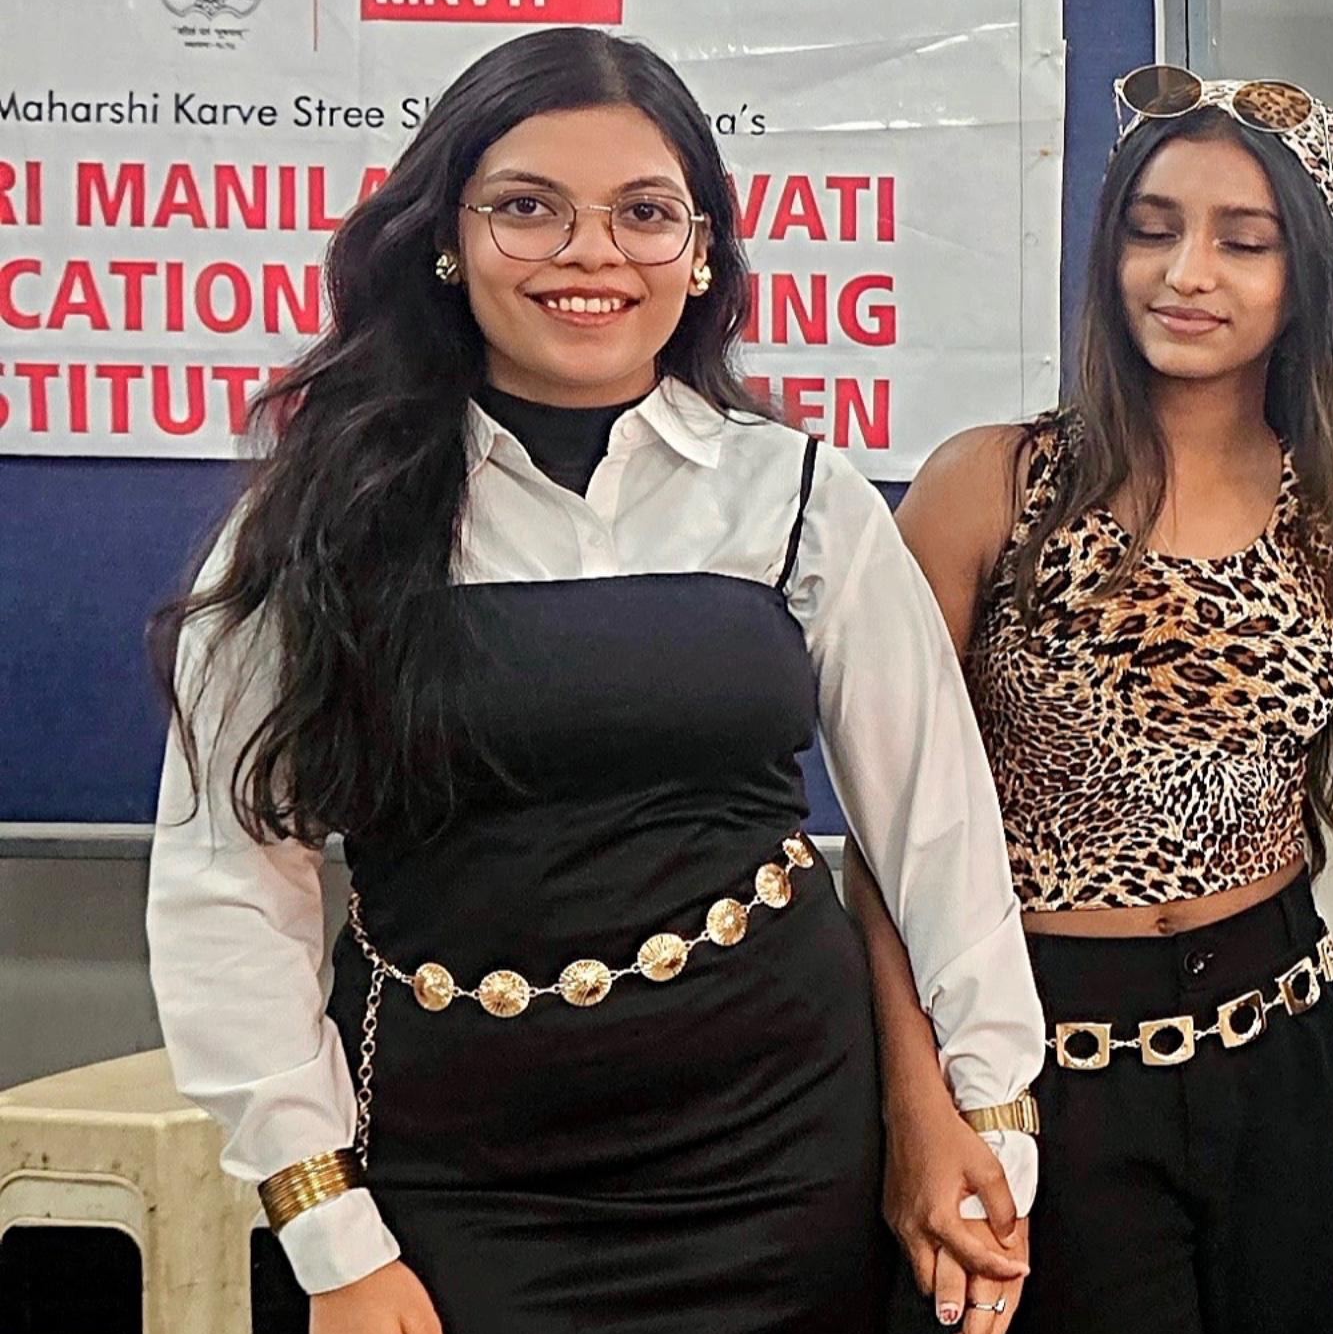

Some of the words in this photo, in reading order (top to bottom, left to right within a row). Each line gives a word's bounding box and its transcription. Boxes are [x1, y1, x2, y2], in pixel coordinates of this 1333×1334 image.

[0, 90, 159, 125] Maharshi
[174, 92, 278, 126] Karve
[293, 95, 385, 128] Stree
